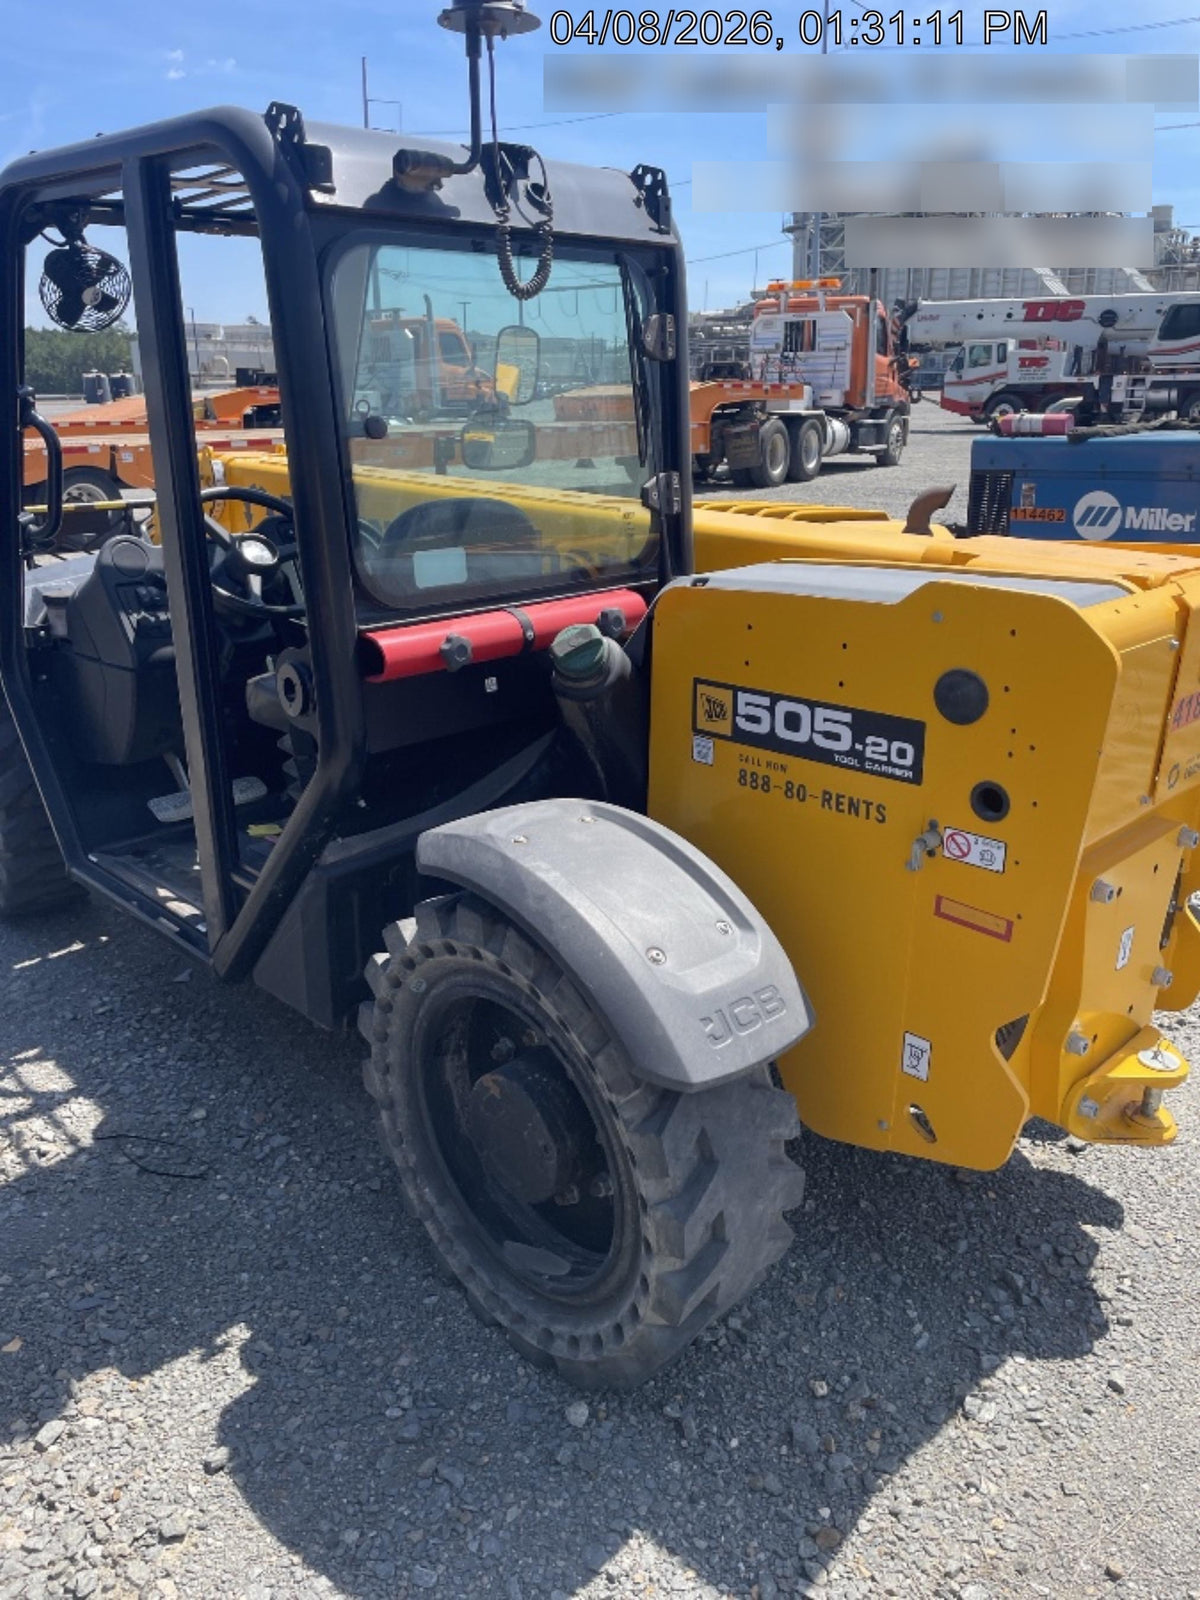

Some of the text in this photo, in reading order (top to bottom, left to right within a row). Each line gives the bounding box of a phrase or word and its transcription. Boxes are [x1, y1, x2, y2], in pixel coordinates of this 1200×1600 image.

[1013, 508, 1064, 522] 114462
[1124, 506, 1195, 532] Miller
[833, 753, 861, 767] TOOL
[738, 769, 887, 824] 888-80-RENTS
[699, 984, 787, 1050] JCB
